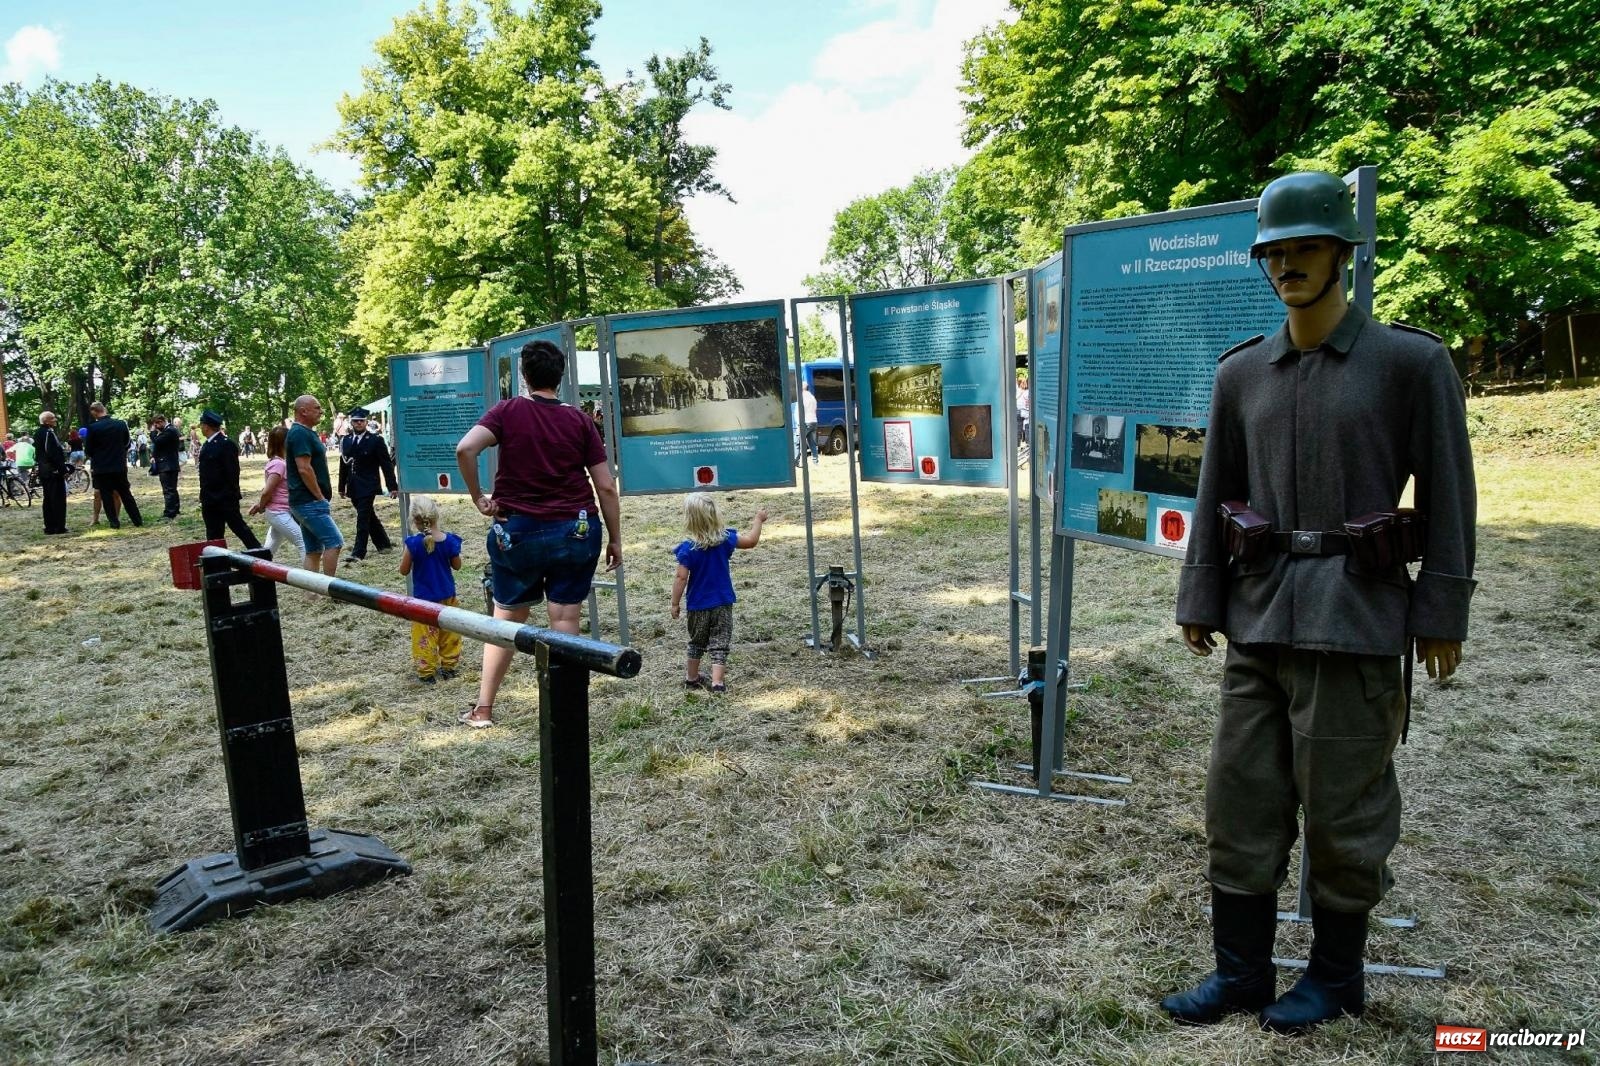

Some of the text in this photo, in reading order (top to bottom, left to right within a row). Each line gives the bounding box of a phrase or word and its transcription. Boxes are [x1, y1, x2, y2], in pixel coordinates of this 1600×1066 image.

[1149, 233, 1219, 252] Wodzisław
[1121, 248, 1251, 274] w II Rzeczpospolitej
[891, 303, 929, 315] Powstanie
[931, 299, 960, 311] Śląskie
